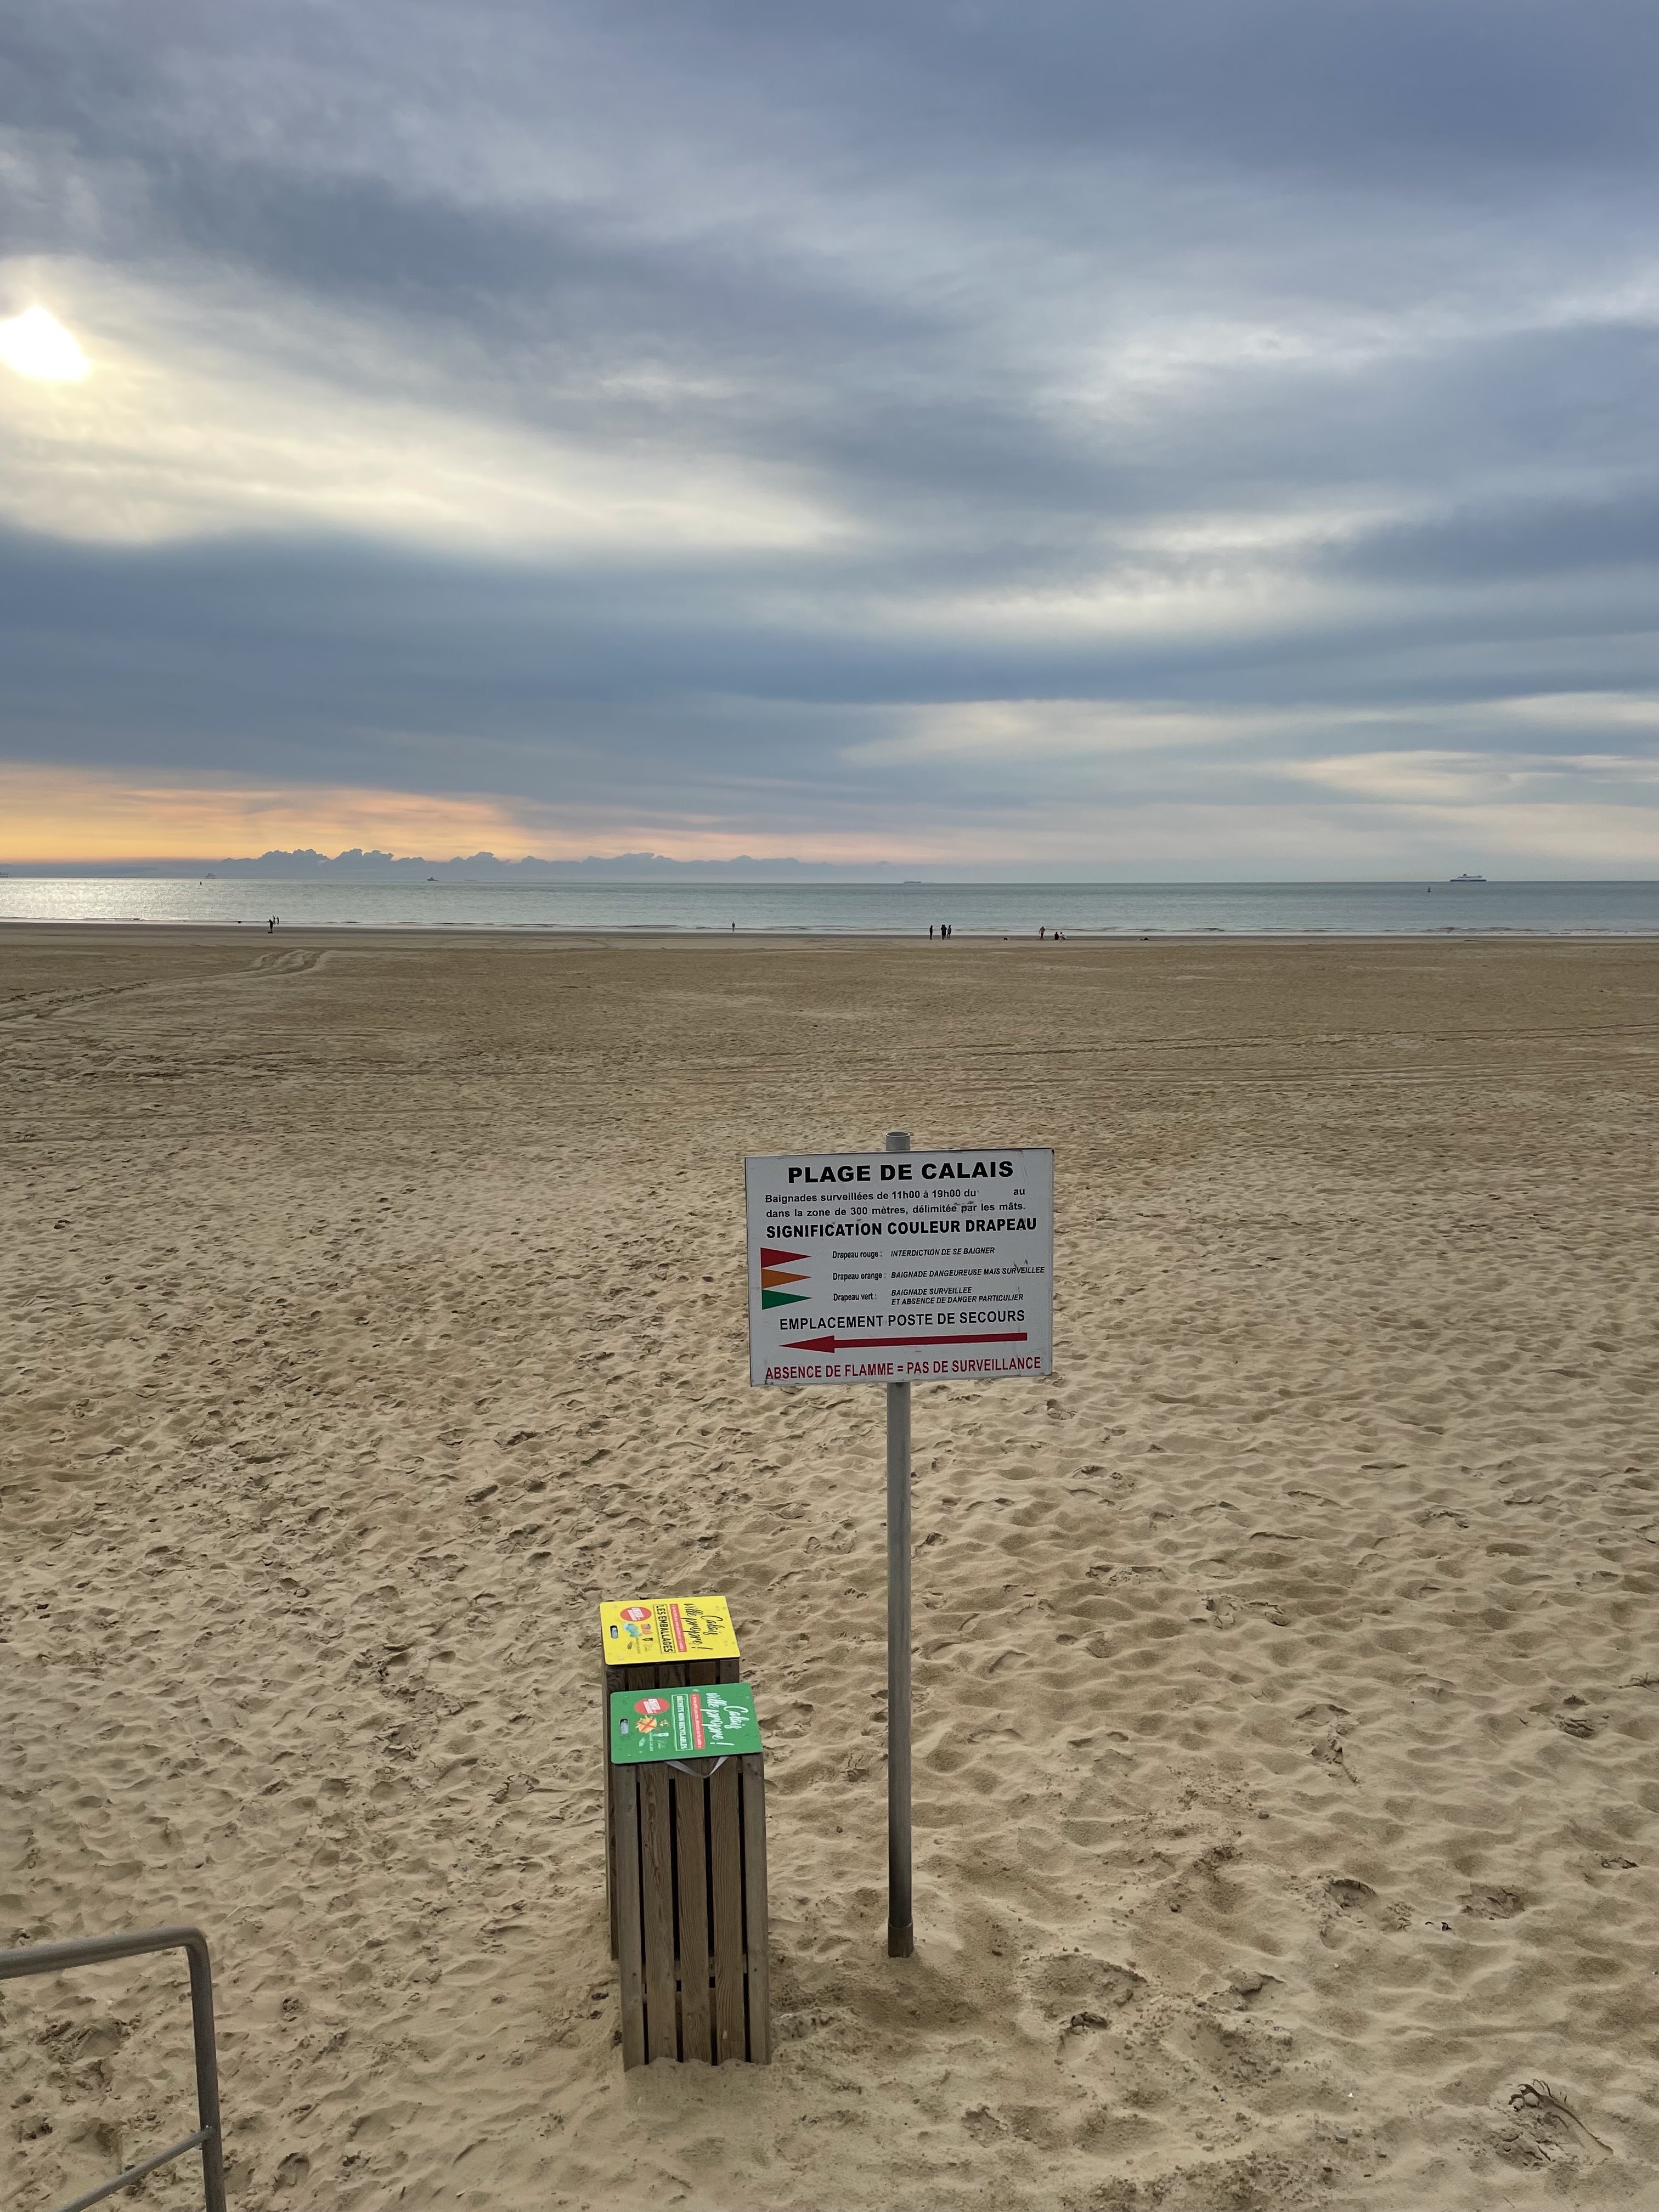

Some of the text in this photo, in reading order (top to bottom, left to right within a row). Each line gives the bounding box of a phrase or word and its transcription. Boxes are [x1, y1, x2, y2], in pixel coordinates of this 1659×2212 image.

[788, 1161, 1014, 1183] PLAGE DE CALAIS
[765, 1194, 817, 1204] Baignades
[820, 1192, 874, 1201] surveillées
[877, 1192, 889, 1200] de
[892, 1190, 920, 1199] 11h00
[923, 1190, 929, 1198] à
[932, 1189, 961, 1198] 19h00
[964, 1188, 976, 1197] du
[766, 1209, 790, 1218] dans
[850, 1206, 868, 1215] 300
[871, 1205, 909, 1215] mètres,
[913, 1203, 957, 1214] délimitée
[961, 1203, 977, 1214] par
[981, 1203, 995, 1211] les
[999, 1202, 1025, 1211] mâts.
[766, 1217, 1036, 1238] SIGNIFICATION COULEUR DRAPEAU
[832, 1250, 858, 1260] Drapeau
[860, 1251, 879, 1260] rouge
[890, 1248, 939, 1257] INTERDICTION
[941, 1248, 952, 1256] DE
[963, 1246, 995, 1255] BAIGNER
[833, 1272, 859, 1281] Drapeau
[860, 1273, 883, 1281] orange
[891, 1270, 927, 1278] BAIGNADE
[928, 1268, 983, 1277] DANGEUREUSE
[1001, 1266, 1045, 1274] SURVEILLEE
[833, 1293, 859, 1302] Drapeau
[860, 1292, 873, 1301] vert
[891, 1288, 927, 1296] BAIGNADE
[929, 1286, 972, 1295] SURVEILLEE
[901, 1295, 934, 1305] ABSENCE
[947, 1295, 977, 1304] DANGER
[978, 1294, 1024, 1302] PARTICULIER
[780, 1310, 1025, 1330] EMPLACEMENT POSTE DE SECOURS
[765, 1365, 822, 1379] ABSENCE
[826, 1364, 841, 1378] DE
[845, 1362, 894, 1377] FLAMME
[907, 1361, 929, 1374] PAS
[933, 1361, 949, 1373] DE
[952, 1356, 1041, 1372] SURVEILLANCE
[684, 1604, 703, 1617] ville
[657, 1605, 673, 1652] LES EMBALLAGES
[681, 1617, 702, 1644] propre
[701, 1616, 725, 1635] Calais
[706, 1693, 727, 1708] ville
[700, 1709, 723, 1740] propre
[724, 1706, 749, 1729] Calais
